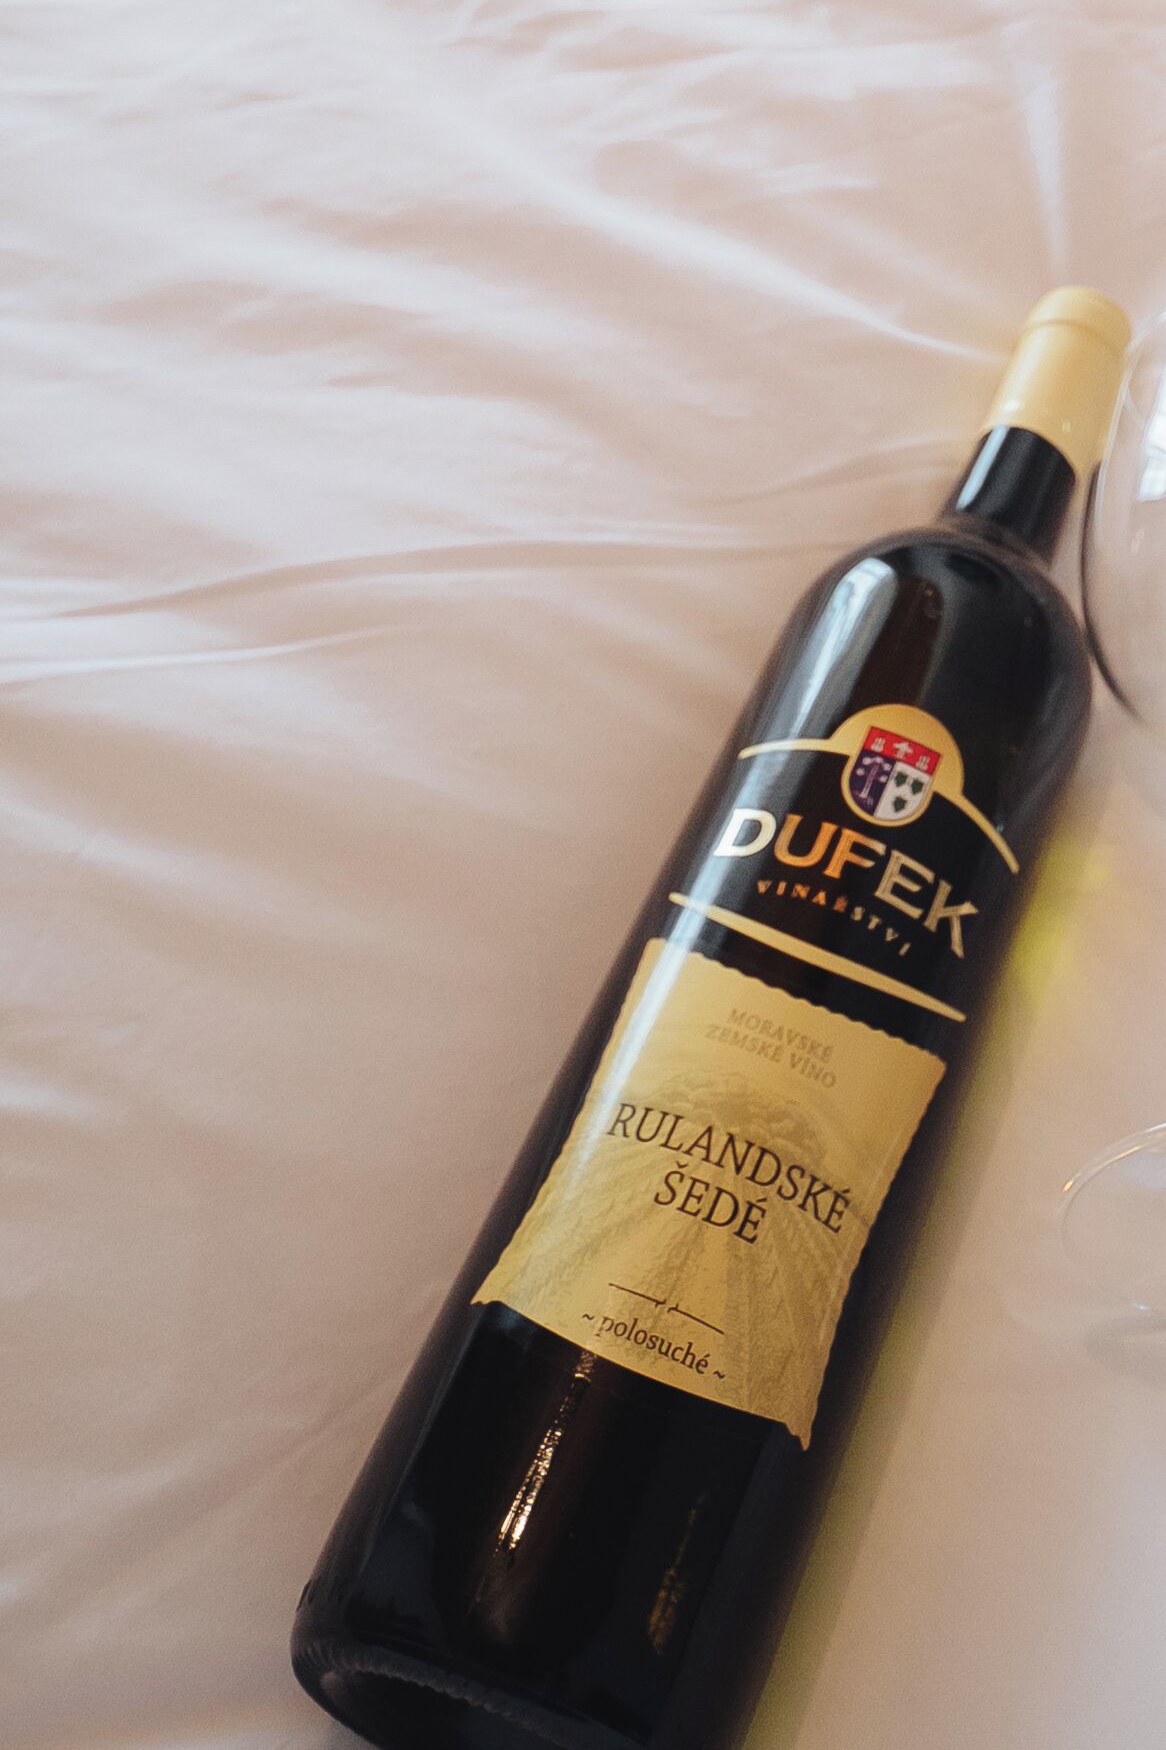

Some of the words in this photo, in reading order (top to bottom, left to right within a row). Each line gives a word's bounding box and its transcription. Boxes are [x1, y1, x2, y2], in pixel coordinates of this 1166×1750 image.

[713, 807, 979, 959] DUFEK
[607, 1102, 852, 1234] RULANDSKÉ
[654, 1160, 768, 1245] ŠEDÉ
